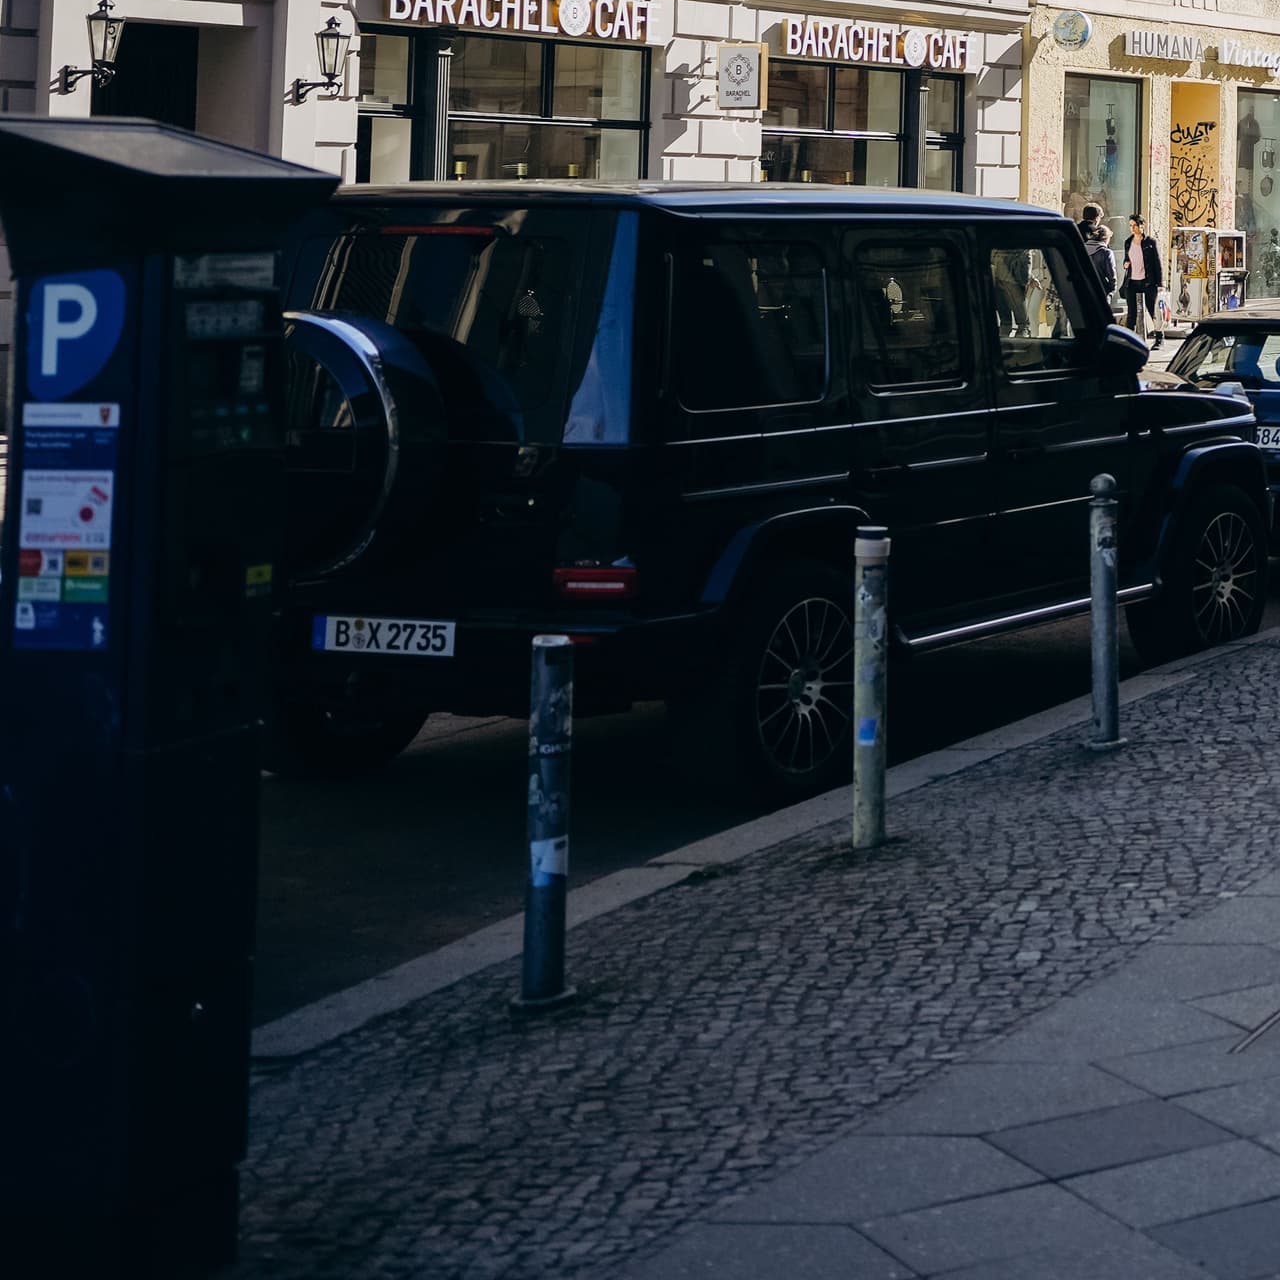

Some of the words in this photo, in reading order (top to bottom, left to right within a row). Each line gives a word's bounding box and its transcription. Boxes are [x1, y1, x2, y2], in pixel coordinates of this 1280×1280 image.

[786, 20, 904, 64] BARACHEL
[1131, 31, 1204, 61] HUMANA
[41, 284, 98, 376] P
[335, 620, 350, 647] B
[366, 622, 382, 649] X
[386, 623, 447, 652] 2735
